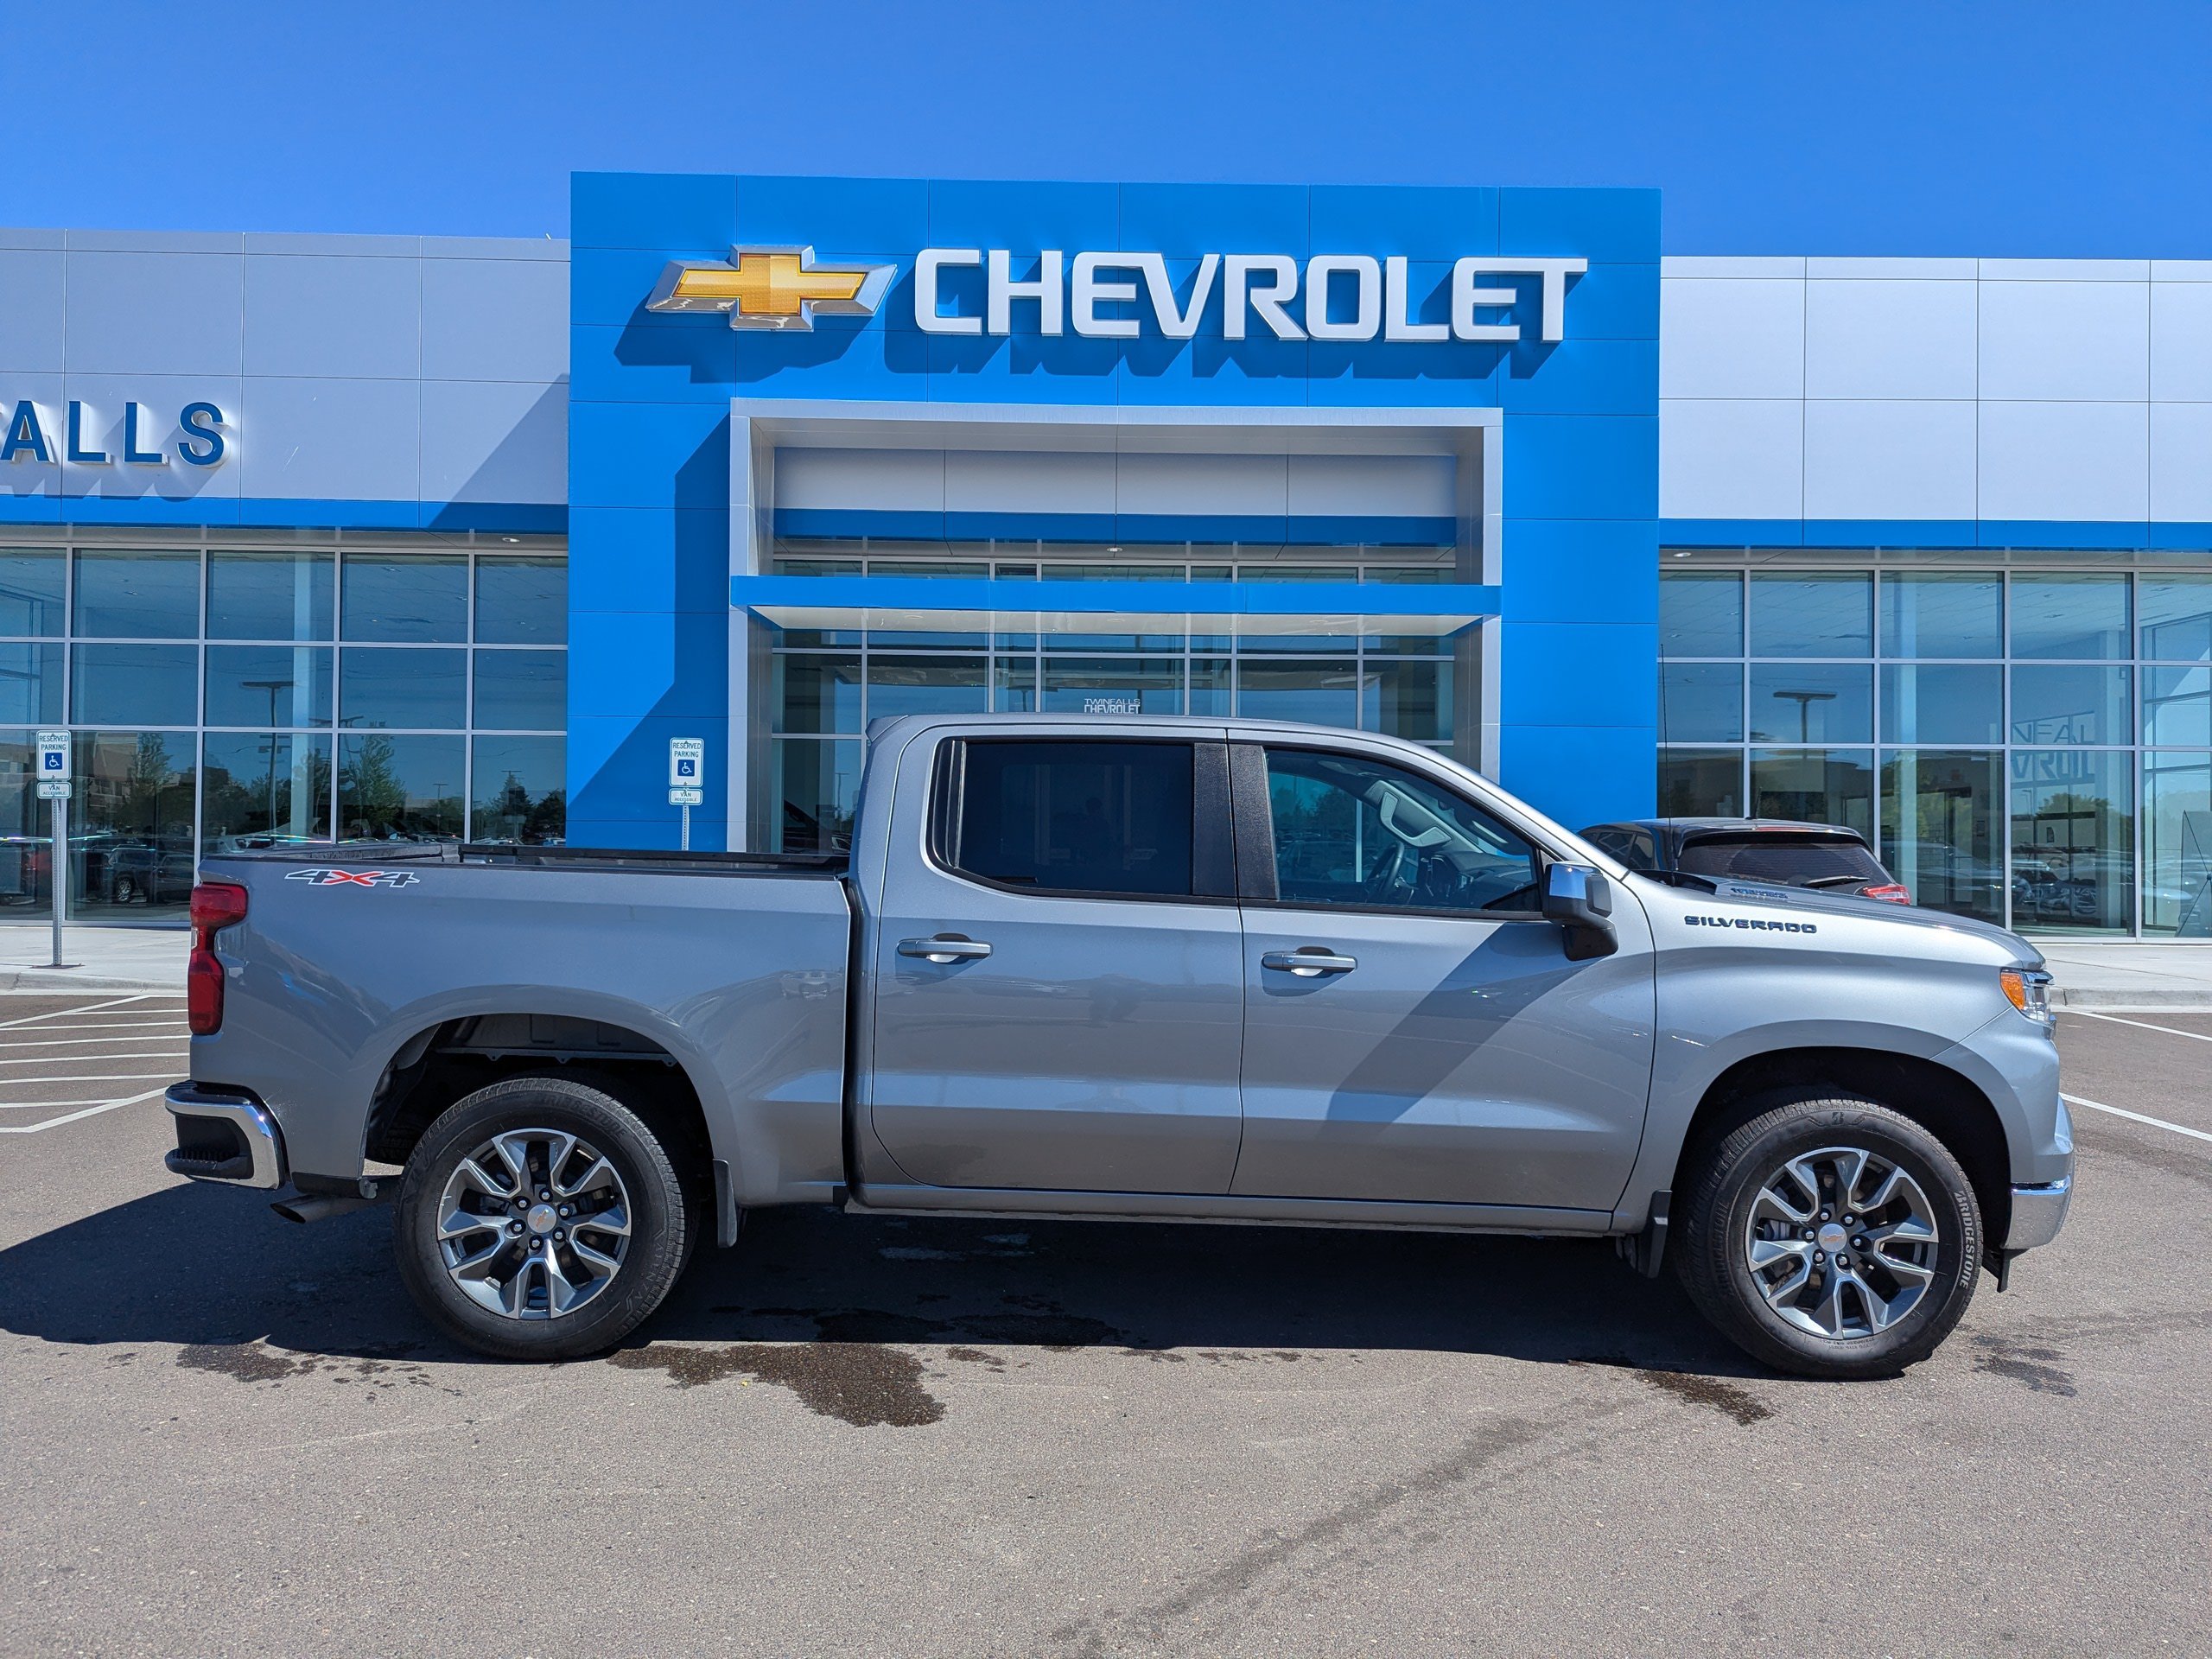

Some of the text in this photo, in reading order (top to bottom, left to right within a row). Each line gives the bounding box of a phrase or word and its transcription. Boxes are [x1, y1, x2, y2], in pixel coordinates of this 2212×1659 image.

[914, 248, 1590, 344] CHEVROLET
[0, 400, 228, 467] ALLS
[1084, 704, 1141, 715] CHEVROLET
[284, 868, 421, 888] 4X4
[1684, 915, 1818, 934] SILVERADO
[1954, 1190, 1975, 1290] BRIDGESTONE
